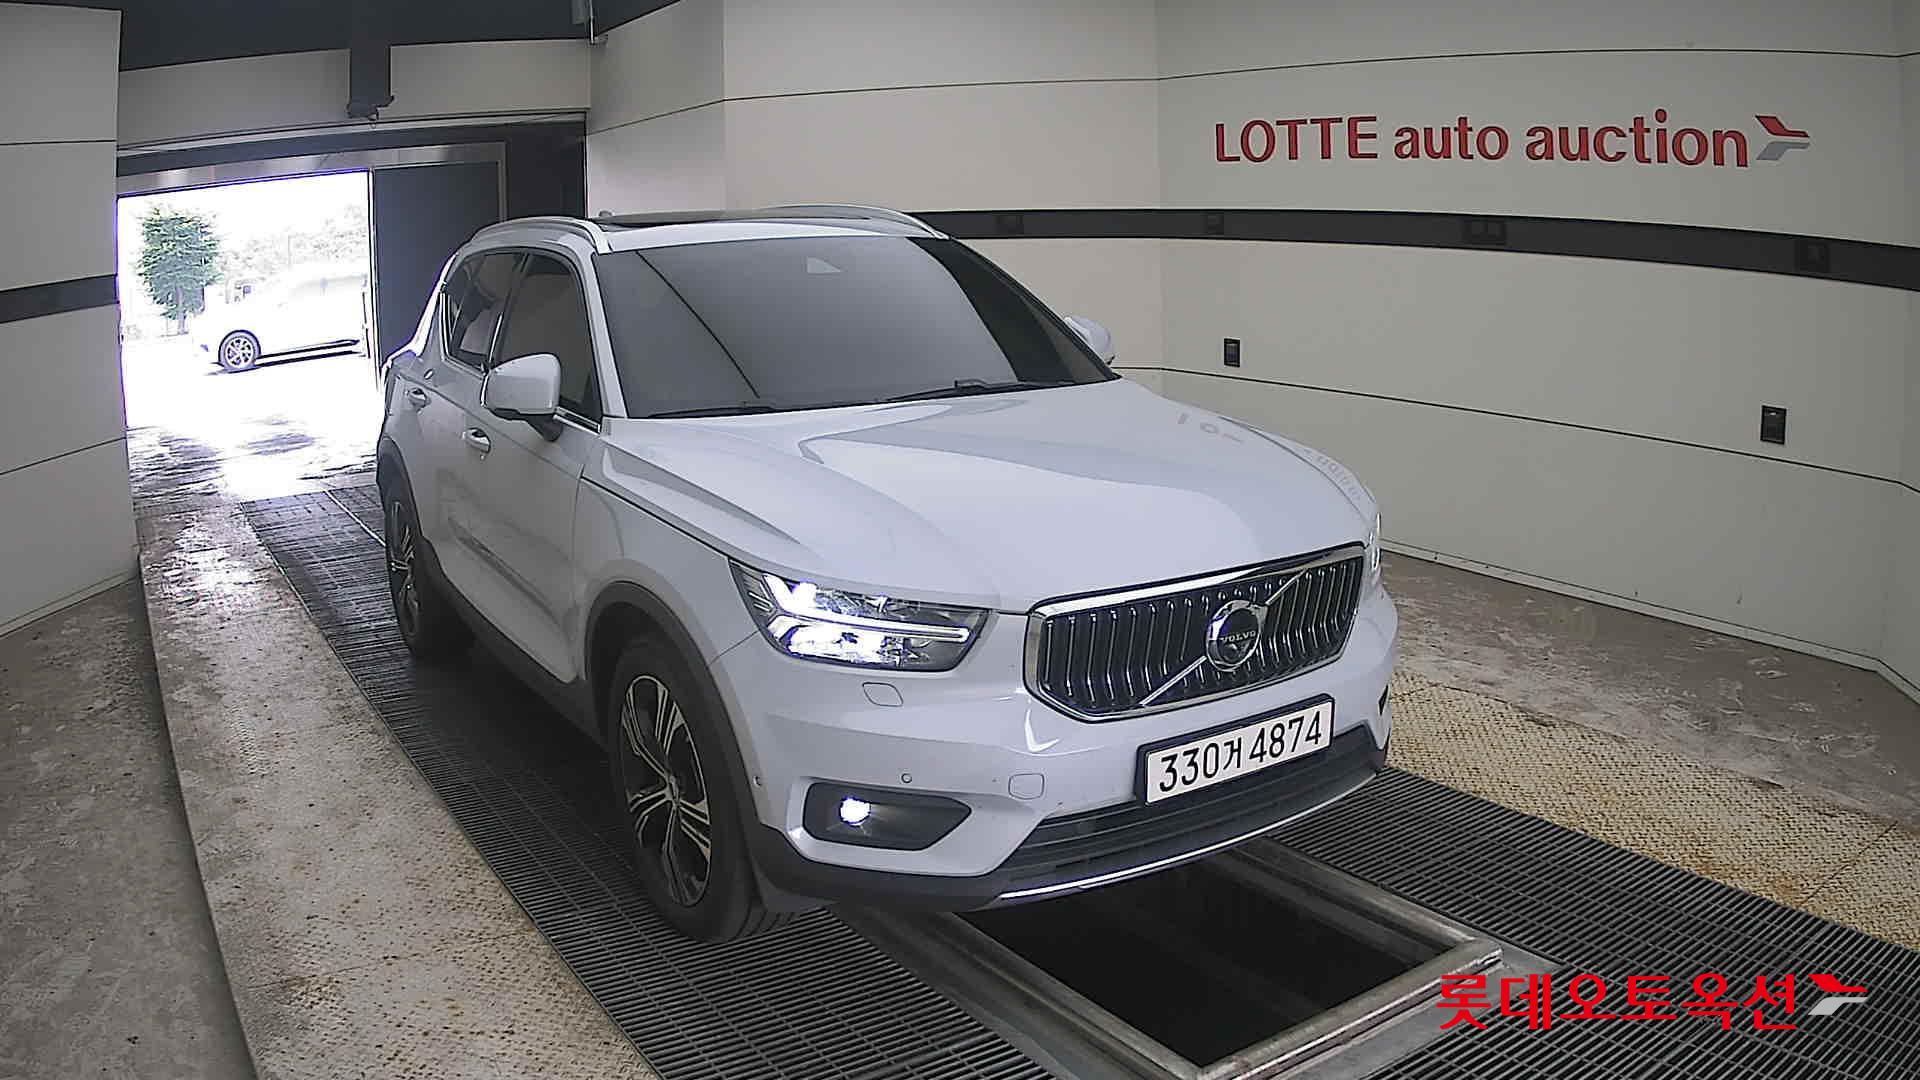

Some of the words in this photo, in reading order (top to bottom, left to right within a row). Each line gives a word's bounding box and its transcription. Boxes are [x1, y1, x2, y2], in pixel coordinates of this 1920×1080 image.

[1215, 116, 1378, 162] LOTTE
[1394, 115, 1509, 160] auto
[1526, 108, 1748, 167] auction
[1159, 736, 1242, 793] 330거
[1248, 710, 1322, 763] 4874
